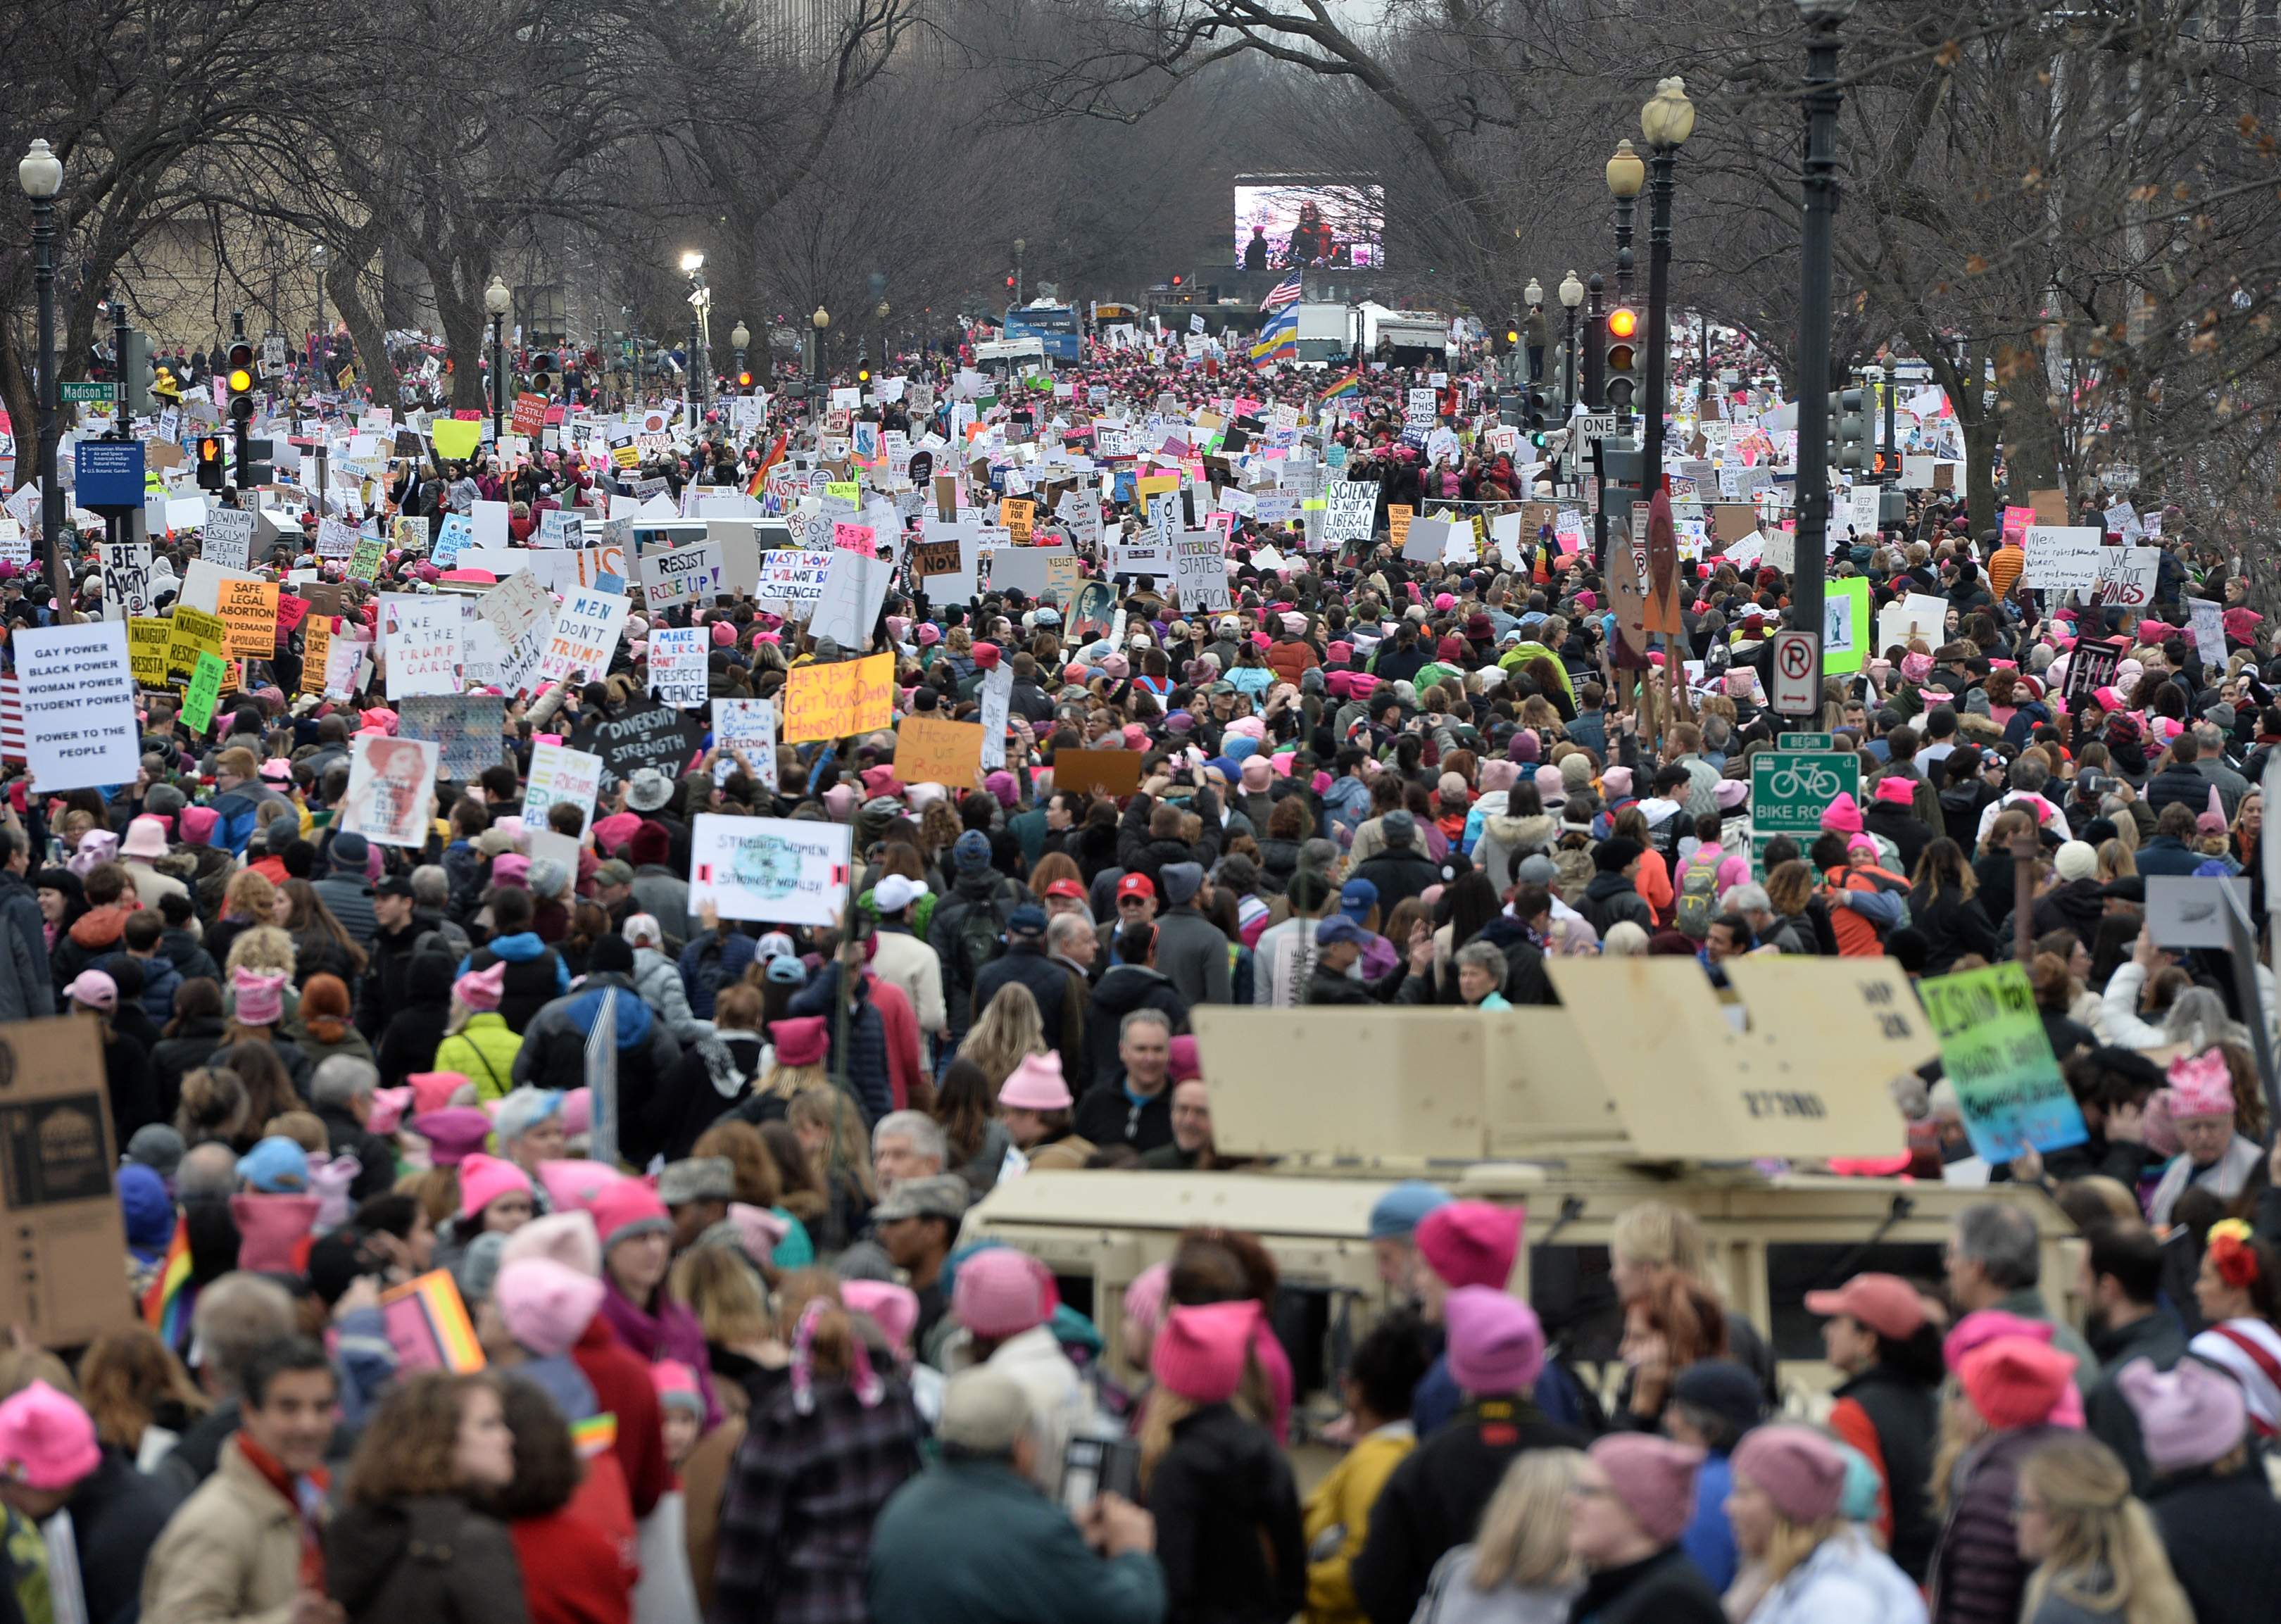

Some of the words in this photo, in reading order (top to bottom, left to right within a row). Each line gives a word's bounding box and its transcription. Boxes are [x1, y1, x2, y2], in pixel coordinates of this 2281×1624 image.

[63, 385, 101, 399] Madison
[1412, 391, 1433, 400] NOT
[524, 407, 543, 418] STILL
[528, 401, 546, 410] FUTURE
[1279, 405, 1297, 417] BLACK
[1412, 402, 1434, 411] THIS
[514, 414, 542, 427] FEMALE
[829, 412, 846, 420] WITH
[1411, 413, 1436, 424] PUSSY
[829, 421, 843, 429] HER
[1403, 427, 1422, 436] LAWS
[1584, 418, 1614, 432] ONE
[1276, 431, 1297, 439] WOMEN
[1487, 432, 1514, 448] NYET
[765, 477, 797, 498] NASTY
[1280, 489, 1300, 498] KNOPE
[1331, 481, 1379, 501] SCIENCE
[1074, 493, 1083, 503] I
[1859, 497, 1871, 505] KEEP
[1008, 501, 1028, 510] FIGHT
[1072, 501, 1090, 512] OWN
[1331, 500, 1338, 510] IS
[1342, 500, 1360, 512] NOT
[1363, 500, 1372, 510] A
[2109, 505, 2130, 517] MAKE
[208, 509, 237, 525] DOWN
[238, 512, 251, 524] WITH
[787, 511, 805, 529] PRO
[1011, 511, 1024, 520] FOR
[1326, 513, 1369, 527] LIBERAL
[207, 524, 249, 542] FASCISM!
[336, 535, 346, 544] IS
[448, 531, 469, 542] WE'RE
[1324, 528, 1371, 541] CONSPIRACY
[205, 541, 215, 550] THE
[358, 538, 383, 553] Respect
[441, 536, 458, 548] STILL
[1177, 541, 1221, 555] UTERUS
[111, 544, 137, 569] BE
[217, 550, 227, 559] IS
[354, 552, 378, 567] Protect
[766, 552, 798, 566] NASTY
[2109, 548, 2135, 567] WE
[659, 550, 707, 574] RESIST
[924, 553, 961, 573] NOW!
[1050, 558, 1074, 567] RESIST
[1180, 555, 1222, 574] STATES
[351, 566, 373, 580] Rights
[761, 569, 768, 581] I
[774, 569, 793, 580] WILL
[793, 569, 811, 582] NOT
[2120, 567, 2146, 583] NOT
[234, 583, 264, 596] SAFE,
[651, 581, 684, 601] RISE
[2101, 580, 2144, 605] HINGS
[230, 594, 265, 607] LEGAL
[1183, 588, 1229, 608] AMERICA
[220, 607, 275, 618] ABORTION
[574, 598, 612, 619] MEN
[175, 615, 221, 643] INAUGURATE
[234, 622, 272, 632] DEMAND
[411, 617, 431, 628] WE
[132, 627, 170, 644] INAUGUR
[230, 634, 273, 646] APOLOGIES!
[404, 634, 412, 643] R
[424, 629, 453, 642] THE
[659, 631, 694, 642] MAKE
[35, 648, 59, 659] GAY
[65, 643, 108, 655] POWER
[149, 646, 161, 655] the
[308, 639, 325, 653] PLACE
[552, 638, 603, 663] TRUMP
[29, 665, 70, 677] BLACK
[74, 660, 118, 672] POWER
[131, 656, 163, 674] RESISTA
[407, 660, 451, 674] CARD
[656, 669, 701, 681] RESPECT
[791, 669, 822, 687] HEY
[27, 681, 75, 694] WOMAN
[80, 677, 123, 688] POWER
[25, 698, 82, 712] STUDENT
[86, 693, 130, 705] POWER
[788, 690, 819, 715] GET
[822, 687, 857, 710] YOUR
[610, 707, 677, 739] DIVERSITY
[788, 715, 835, 738] HANDS
[860, 707, 888, 729] HER
[35, 731, 78, 742] POWER
[84, 729, 99, 738] TO
[103, 726, 125, 736] THE
[611, 734, 686, 763] STRENGTH
[1791, 736, 1821, 748] BEGIN
[59, 745, 106, 758] PEOPLE
[374, 812, 400, 825] THE
[1756, 805, 1793, 819] BIKE
[717, 835, 777, 850] STRONG
[781, 843, 829, 857] WOMEN
[719, 872, 771, 886] STRONG
